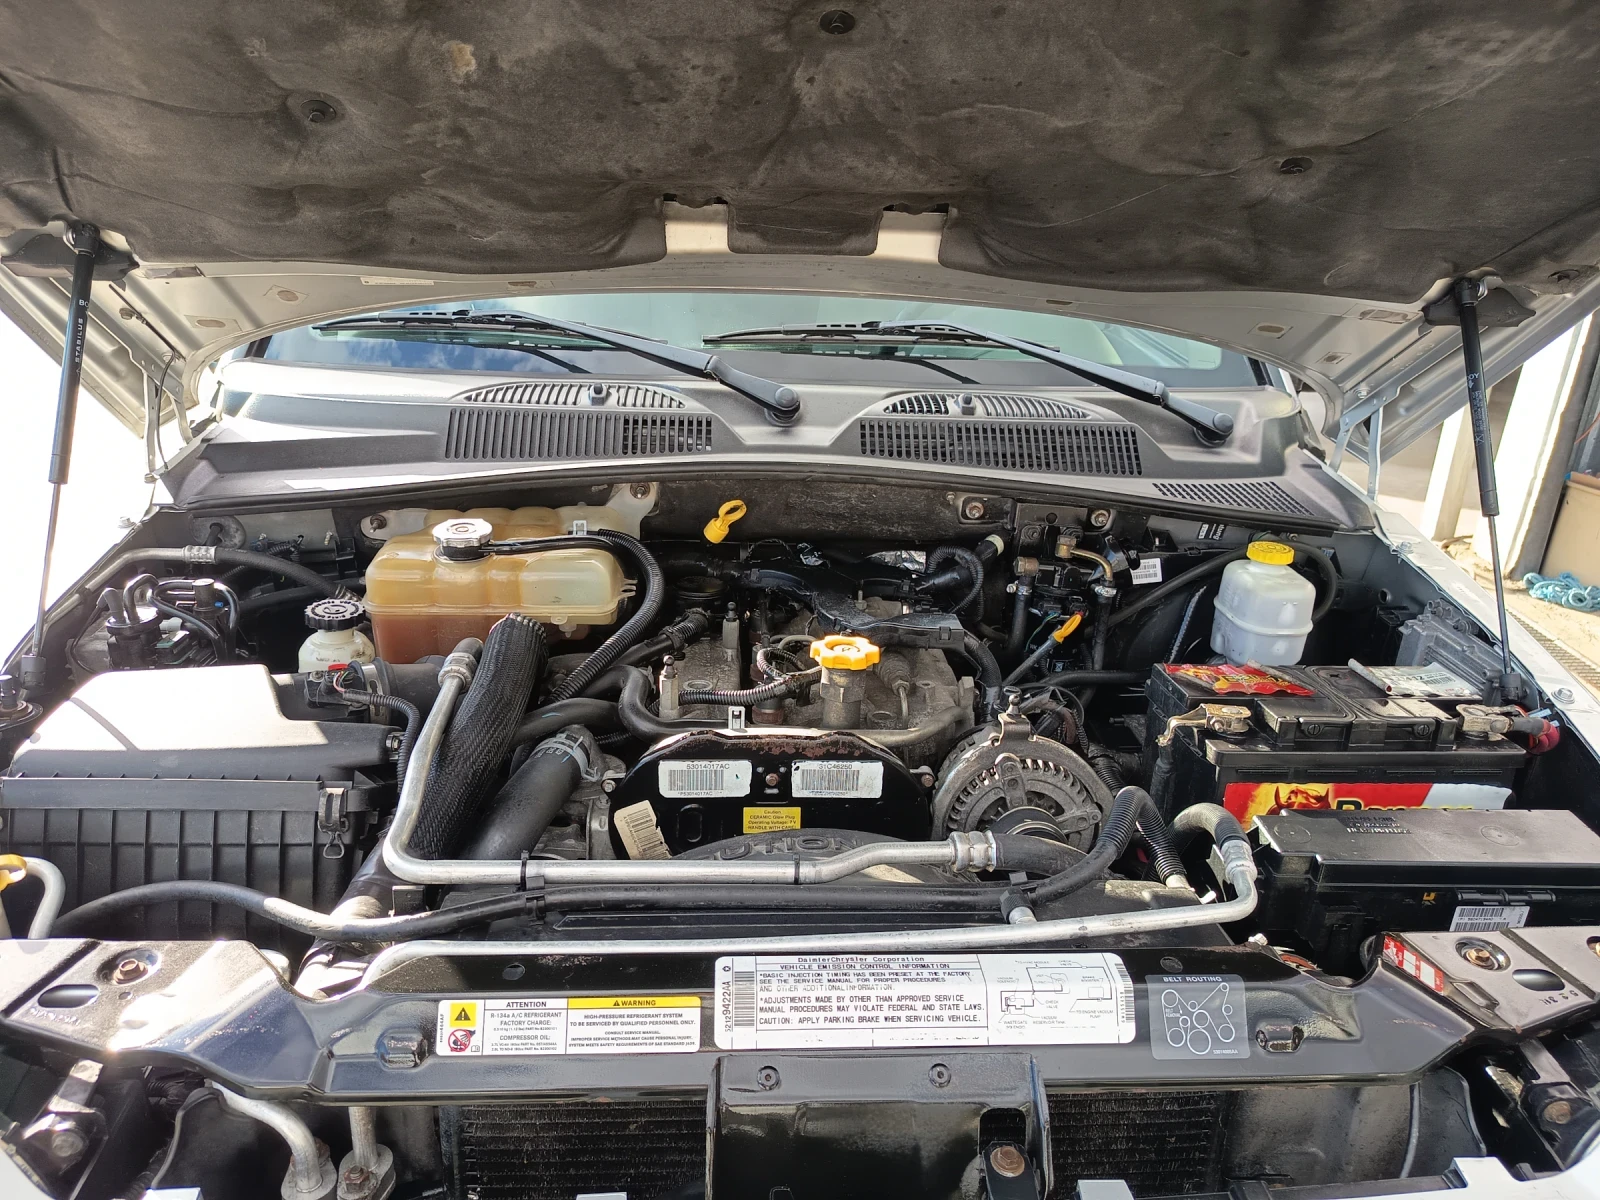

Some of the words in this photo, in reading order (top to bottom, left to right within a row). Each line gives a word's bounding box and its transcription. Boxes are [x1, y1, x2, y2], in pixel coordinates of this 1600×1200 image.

[75, 318, 84, 363] STABILUS
[790, 1005, 833, 1013] PROCEDURES
[854, 1004, 884, 1012] VIOLATE
[964, 1003, 985, 1011] LAWS.
